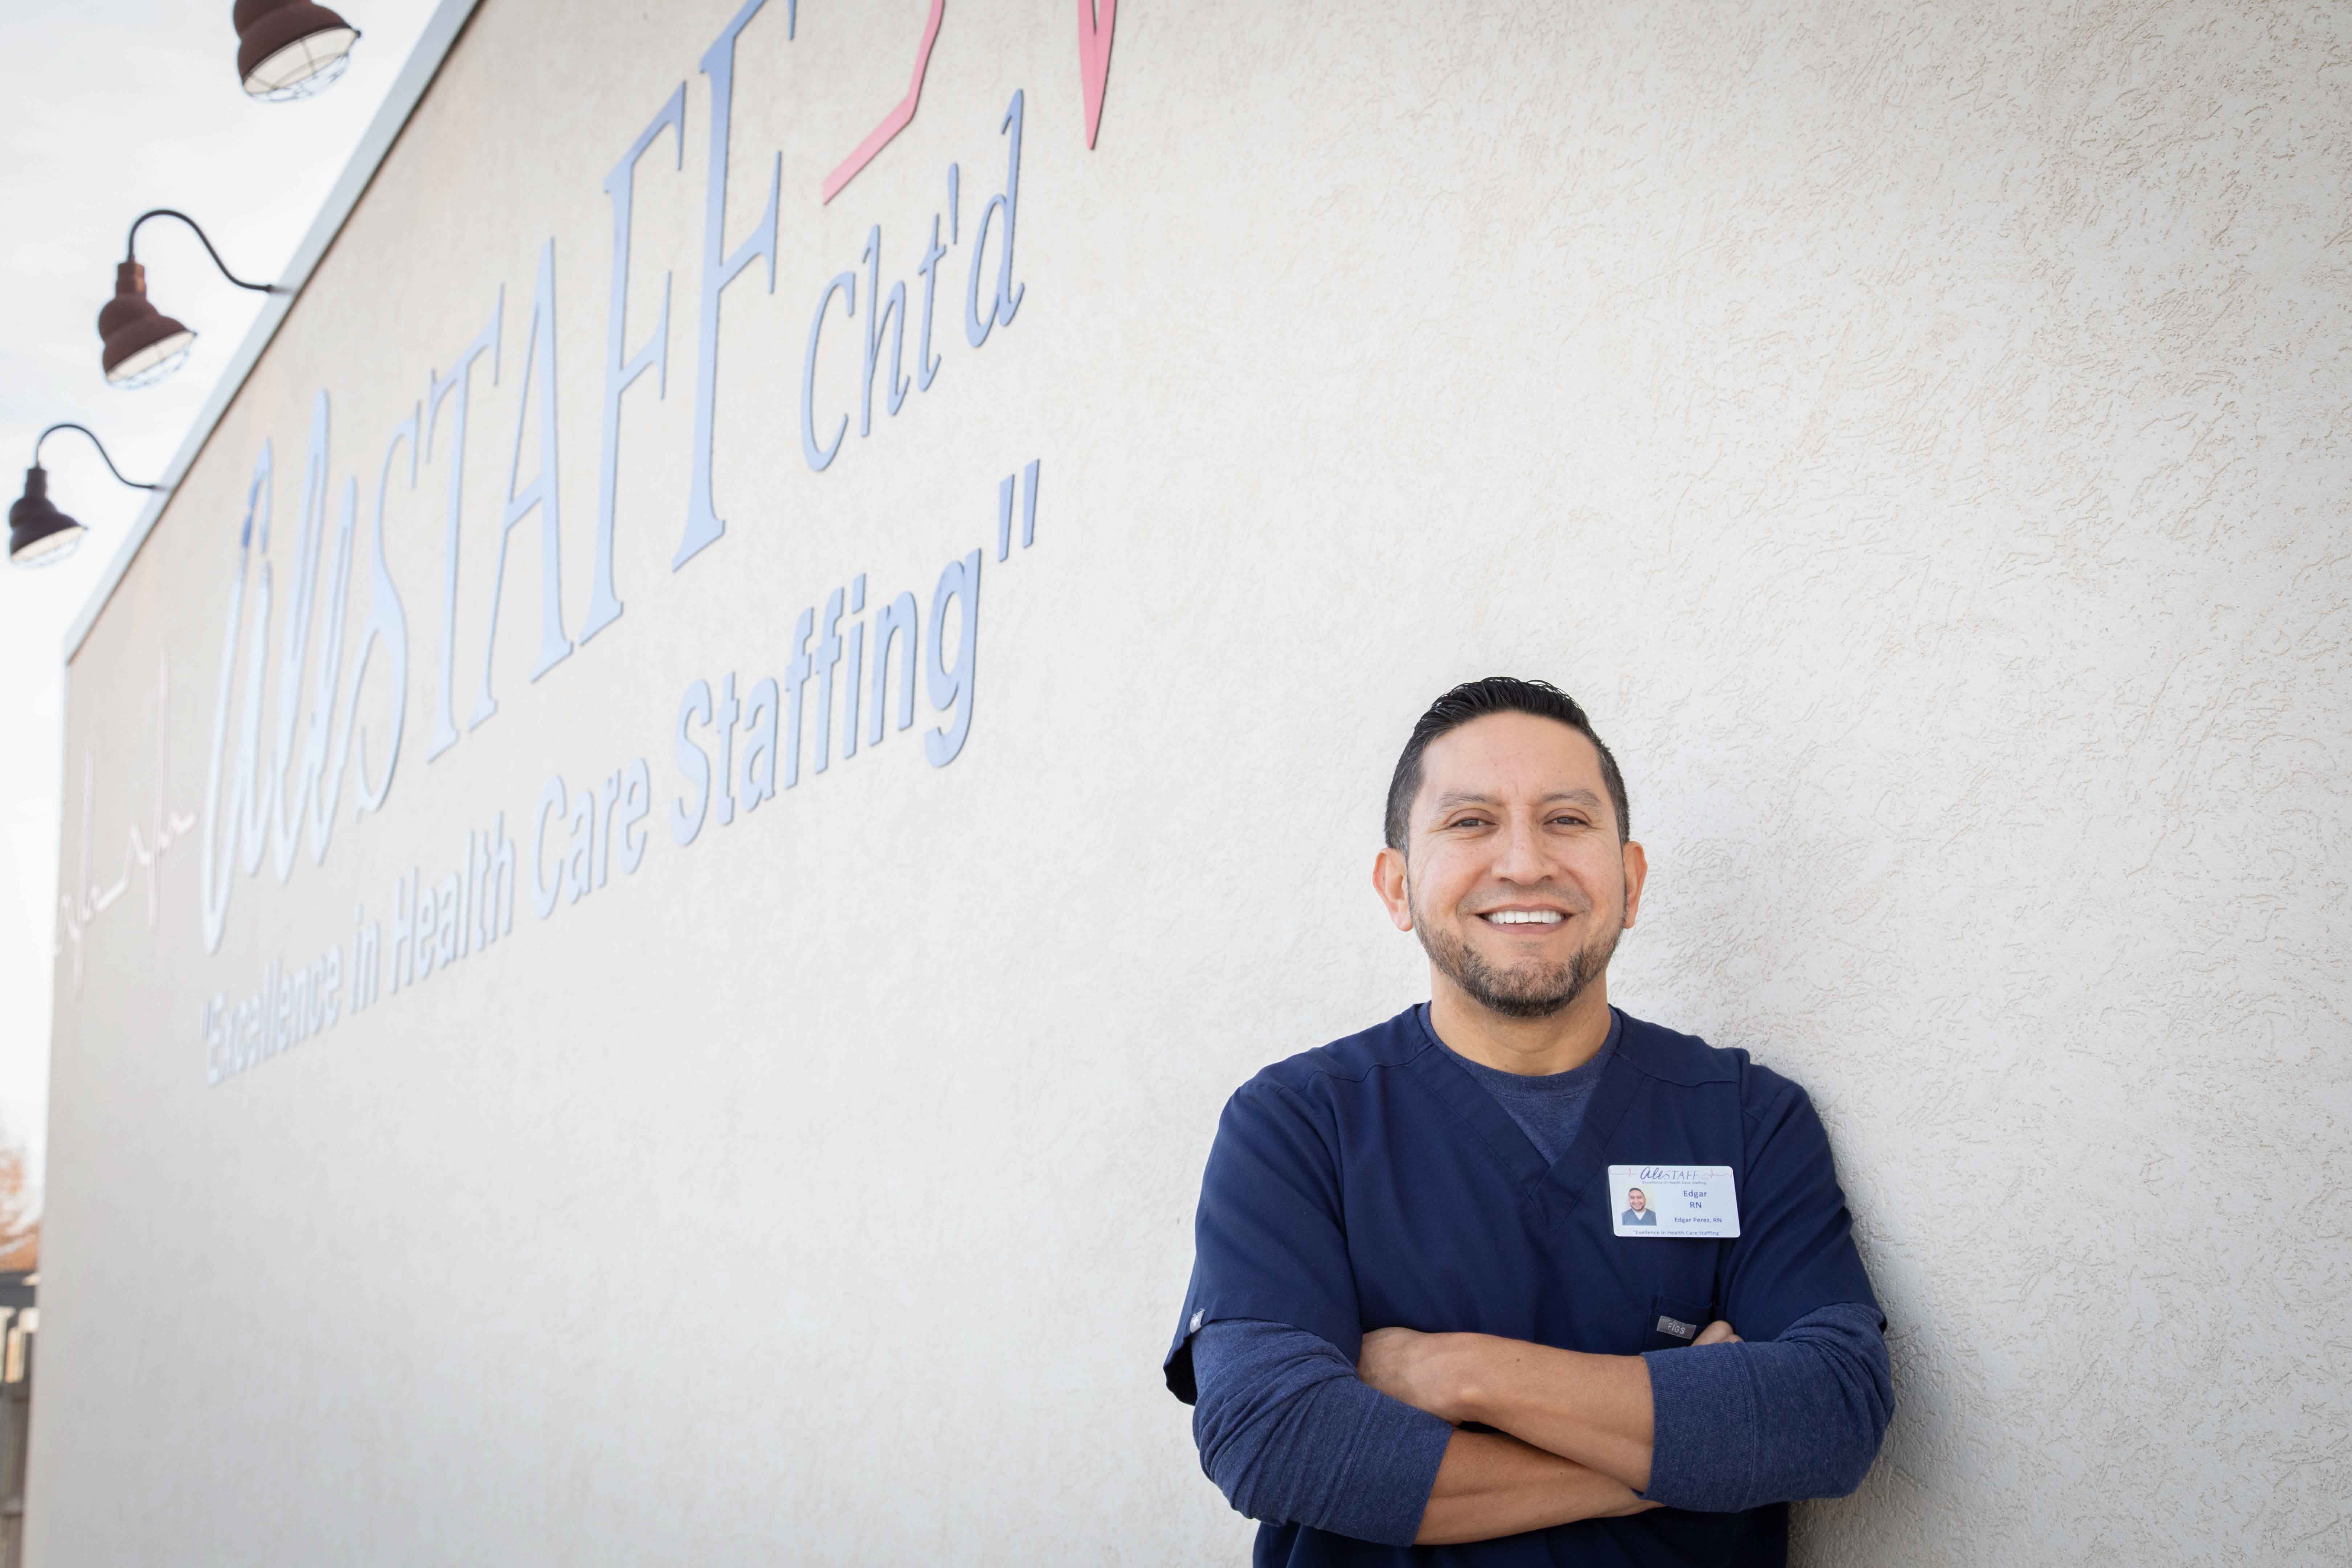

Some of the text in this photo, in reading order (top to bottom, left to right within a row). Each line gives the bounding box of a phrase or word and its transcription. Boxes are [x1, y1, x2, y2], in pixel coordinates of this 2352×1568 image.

[801, 88, 1026, 472] Cht'd
[350, 903, 381, 1016] in
[388, 809, 517, 996] Health
[531, 756, 651, 920] Care
[670, 458, 1040, 847] Staffing"
[1684, 1190, 1707, 1199] Edgar
[1668, 1323, 1685, 1334] FIGS
